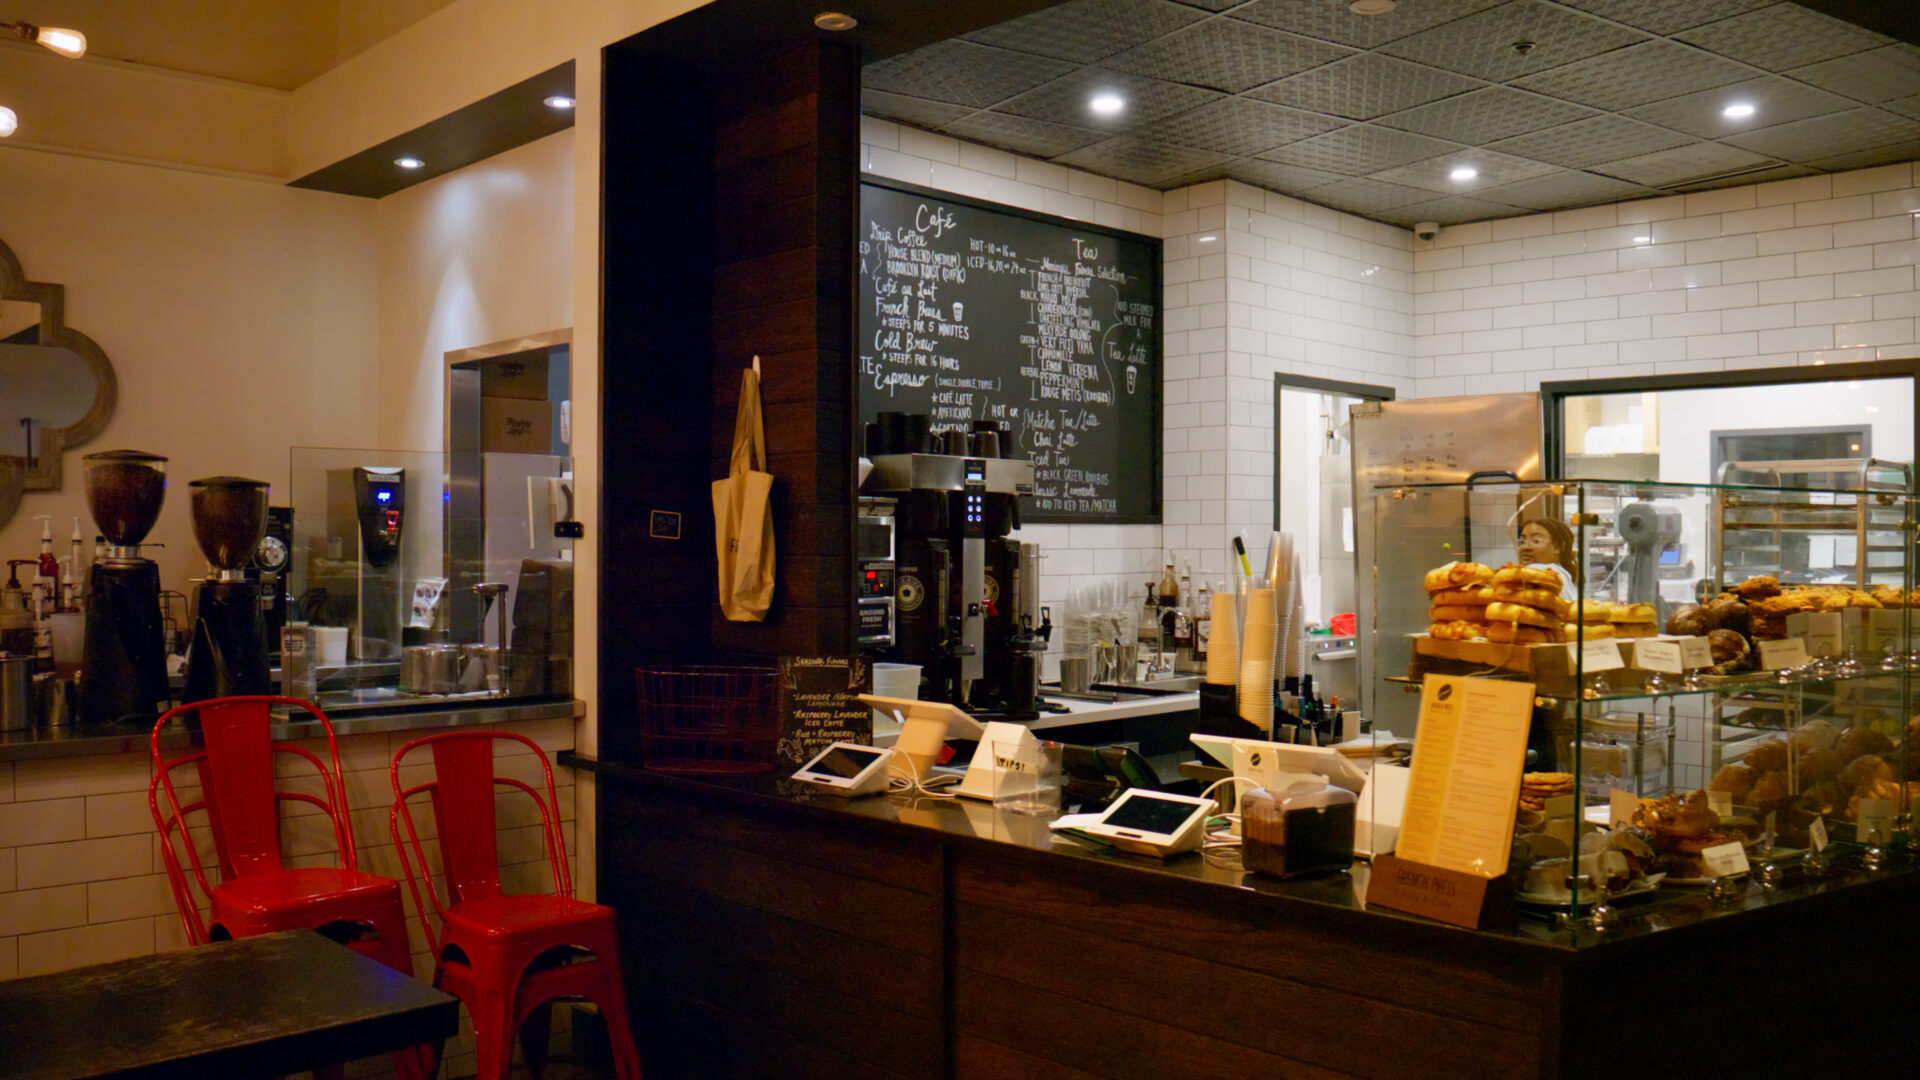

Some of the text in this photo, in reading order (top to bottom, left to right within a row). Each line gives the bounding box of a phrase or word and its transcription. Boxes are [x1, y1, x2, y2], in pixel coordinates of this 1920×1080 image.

[915, 204, 957, 238] Café
[870, 220, 928, 252] Drip Coffee
[888, 244, 908, 261] HOUSE
[910, 248, 931, 264] BLEND
[1072, 239, 1098, 260] Tea
[886, 261, 919, 278] BROOKLYN
[920, 264, 940, 281] ROAST
[875, 277, 938, 302] Café au Lait
[875, 295, 910, 318] French
[888, 317, 970, 341] STEEPS FOR 5 MINUTES
[874, 329, 938, 353] Cold Brew
[1107, 341, 1125, 361] Tea
[888, 352, 960, 371] STEEPS FOR 16 HOURS
[874, 363, 931, 398] Espresso
[955, 392, 974, 407] LATTE
[991, 404, 1007, 419] HOT
